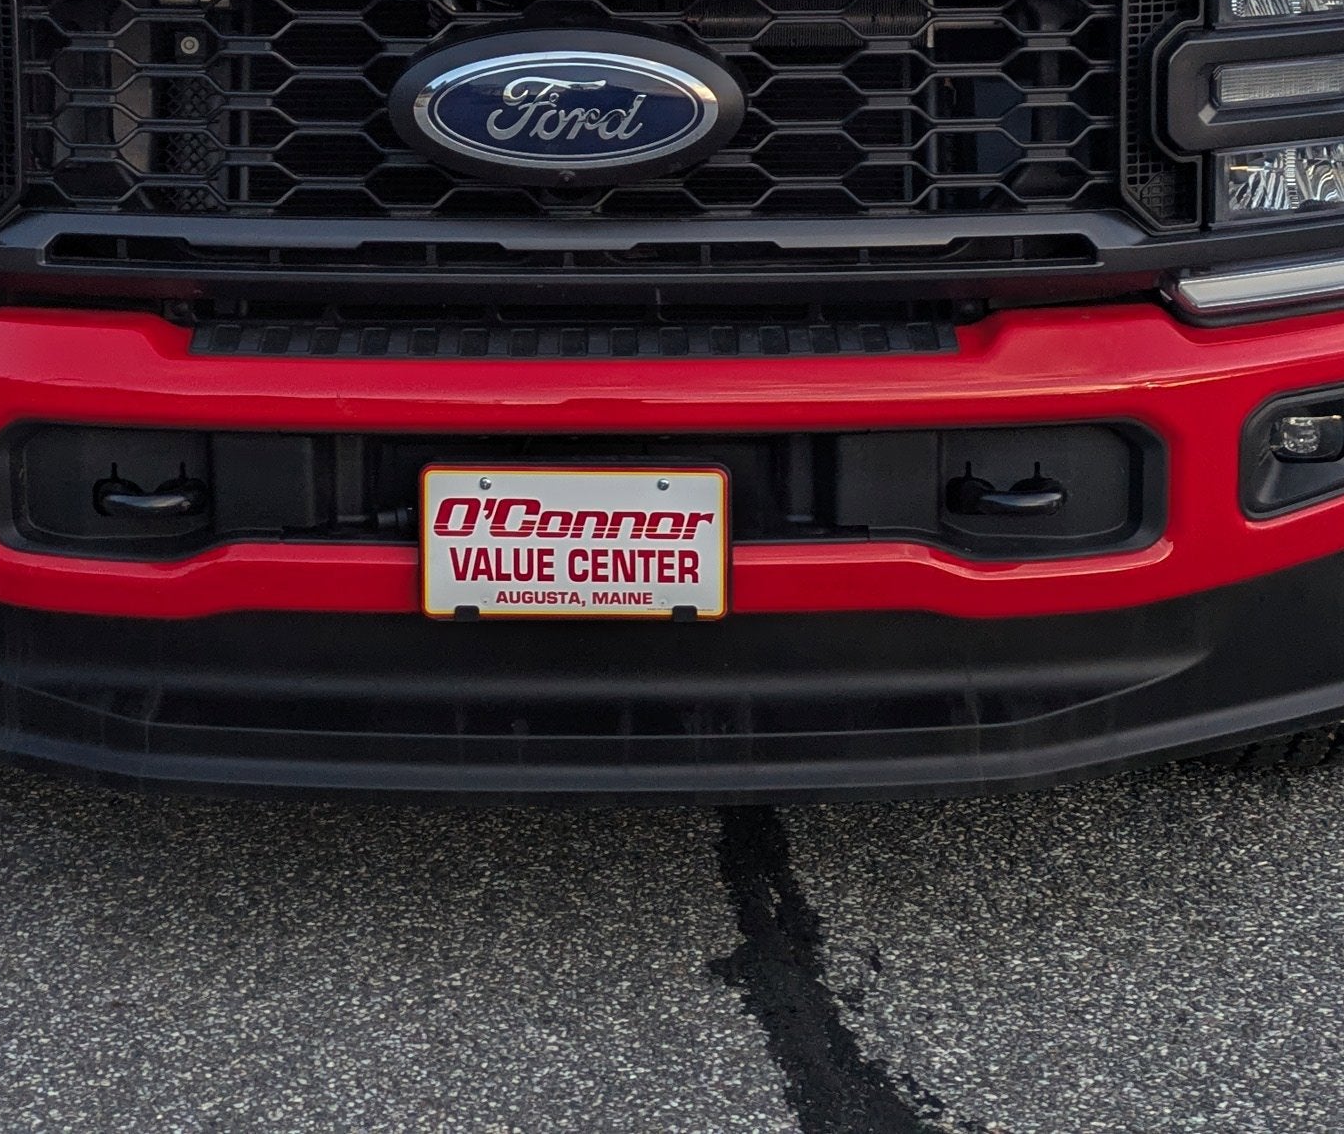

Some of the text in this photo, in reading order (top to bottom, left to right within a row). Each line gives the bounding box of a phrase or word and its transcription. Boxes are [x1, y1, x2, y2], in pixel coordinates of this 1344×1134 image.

[486, 76, 648, 141] Ford
[433, 497, 715, 540] O'Connor
[449, 547, 700, 584] VALUE CENTER
[496, 590, 653, 608] AUGUSTA, MAINE
